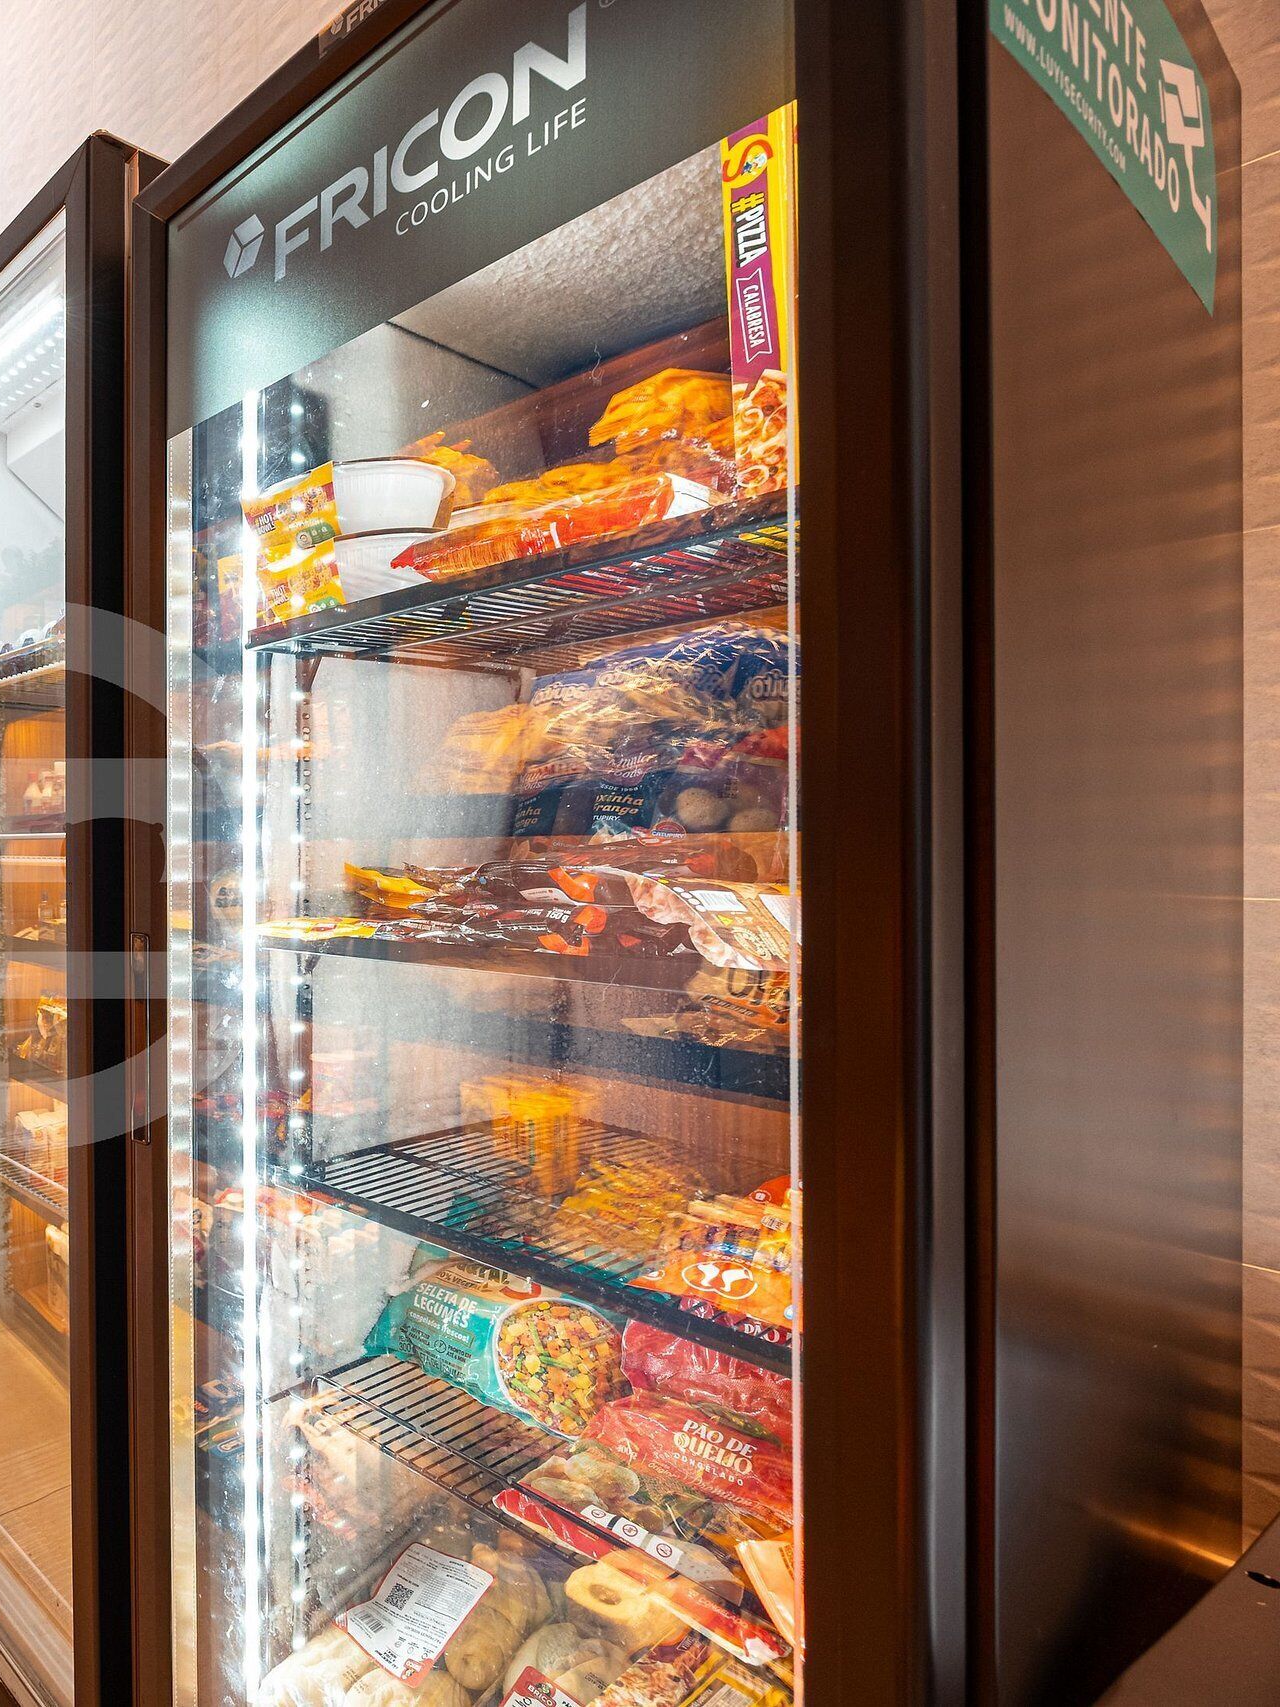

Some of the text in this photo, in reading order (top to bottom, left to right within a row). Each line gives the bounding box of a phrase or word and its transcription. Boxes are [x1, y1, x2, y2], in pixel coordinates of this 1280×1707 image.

[346, 0, 380, 32] FR
[1088, 0, 1147, 93] NTE
[1034, 0, 1180, 213] NITORADO
[274, 1, 587, 283] FRICON
[395, 97, 587, 236] COOLING LIFE
[729, 192, 768, 268] #PIZZA
[742, 284, 766, 348] CALABRESA
[413, 1294, 471, 1329] LEGUMES
[416, 1282, 478, 1314] SELETA DE
[672, 1430, 753, 1476] QUEIJO
[682, 1419, 758, 1460] PÃO DE
[527, 1684, 554, 1706] BRICO
